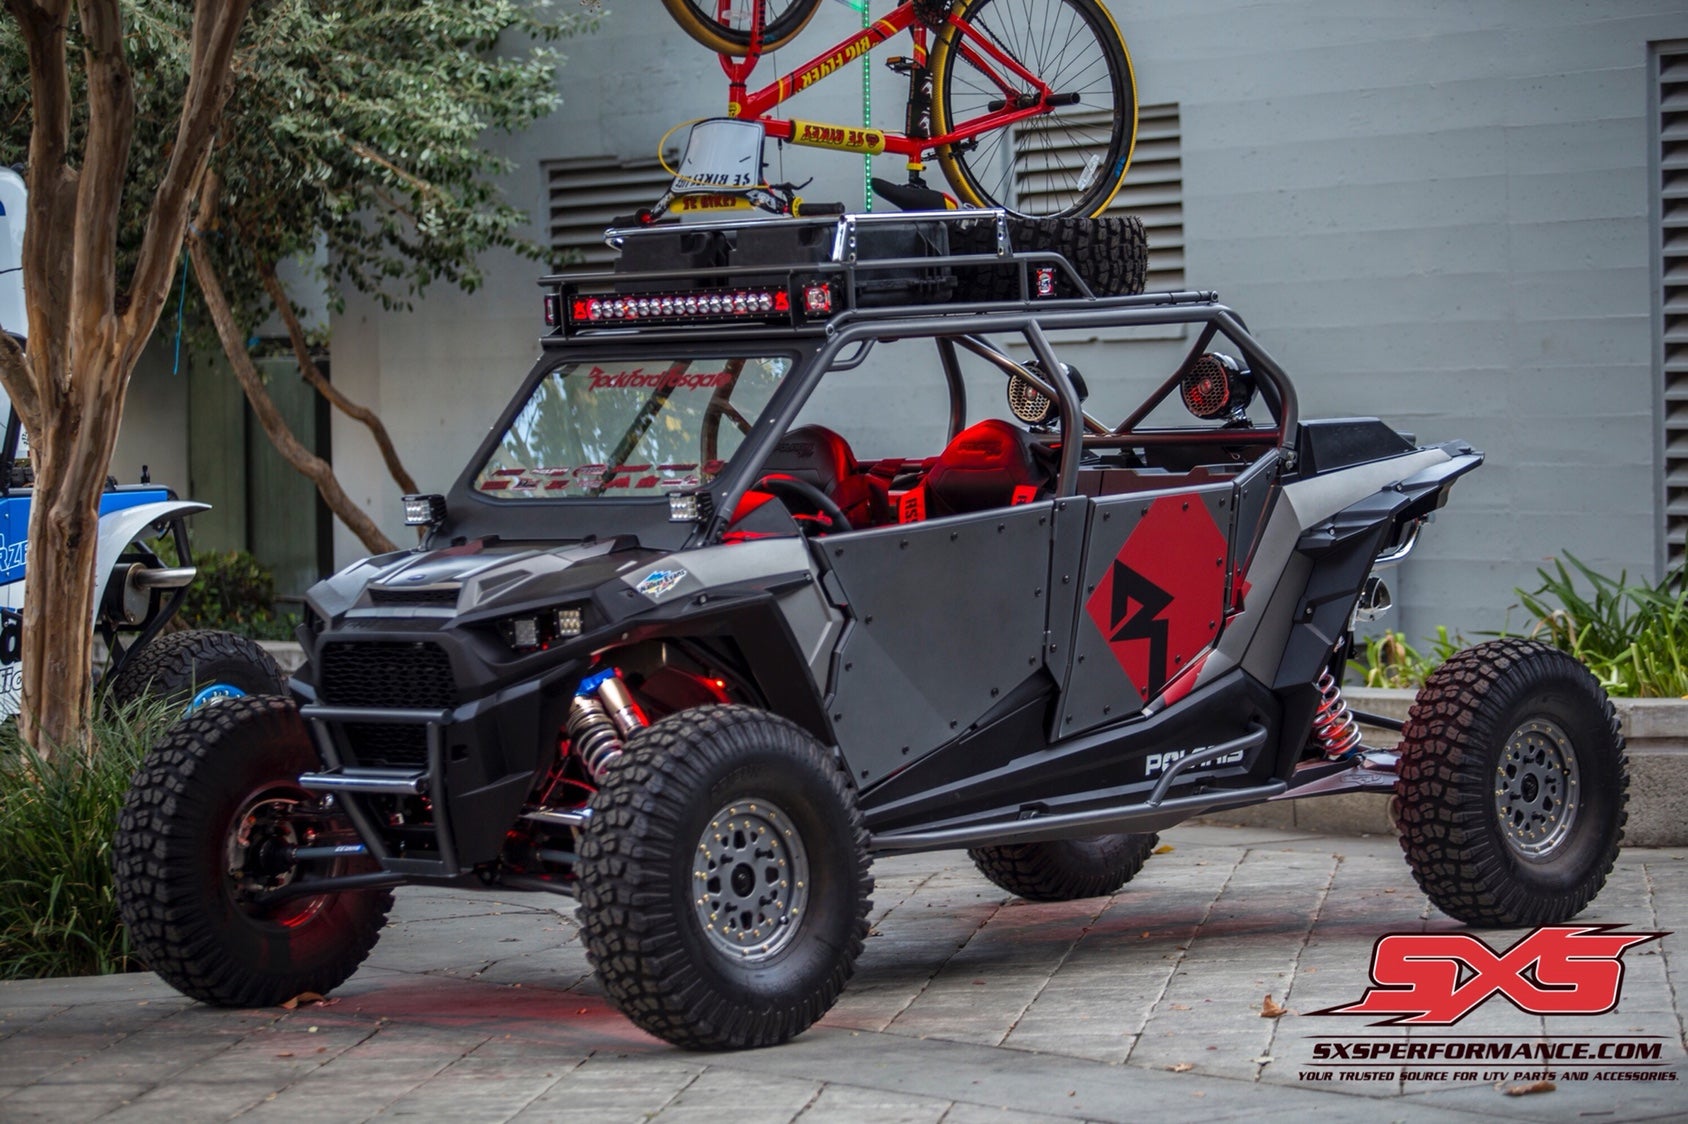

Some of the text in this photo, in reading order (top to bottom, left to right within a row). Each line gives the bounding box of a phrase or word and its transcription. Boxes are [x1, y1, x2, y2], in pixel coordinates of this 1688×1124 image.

[801, 125, 864, 147] SE BIKES
[733, 173, 751, 185] SE
